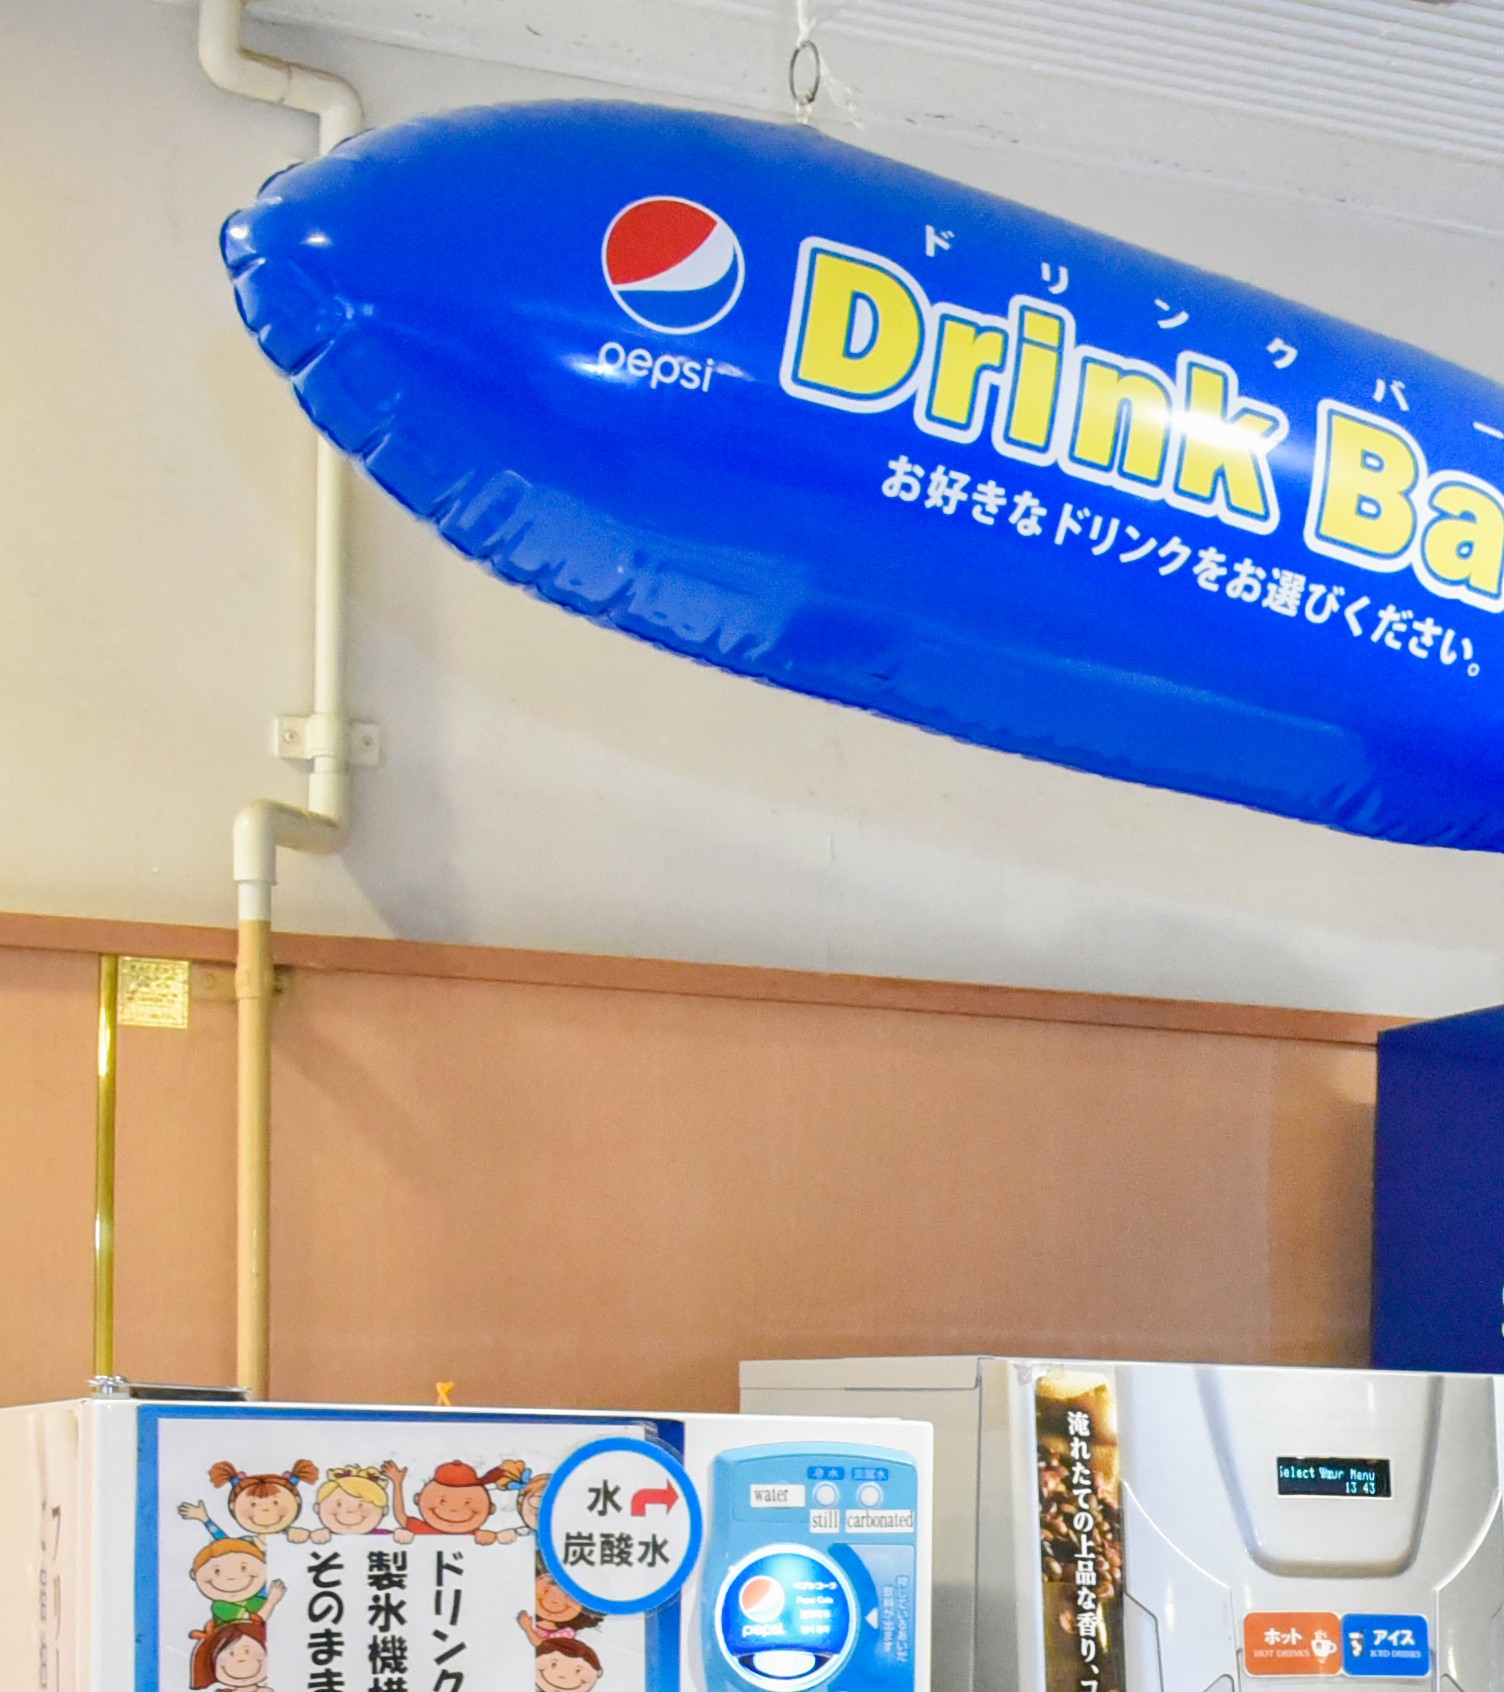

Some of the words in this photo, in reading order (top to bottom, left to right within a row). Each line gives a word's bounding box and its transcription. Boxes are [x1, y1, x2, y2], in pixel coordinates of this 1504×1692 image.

[598, 342, 716, 392] pepsi
[780, 235, 1290, 533] Drink
[881, 451, 1486, 682] お好きなドリンクをお選びください。
[1350, 1468, 1375, 1480] Menu
[587, 1479, 622, 1518] 水
[754, 1487, 789, 1503] water
[812, 1512, 838, 1528] still
[847, 1512, 913, 1528] carbonated
[562, 1532, 671, 1569] 炭酸水
[1264, 1628, 1302, 1645] ホット
[1372, 1630, 1415, 1646] アイス
[1254, 1650, 1274, 1658] HOT
